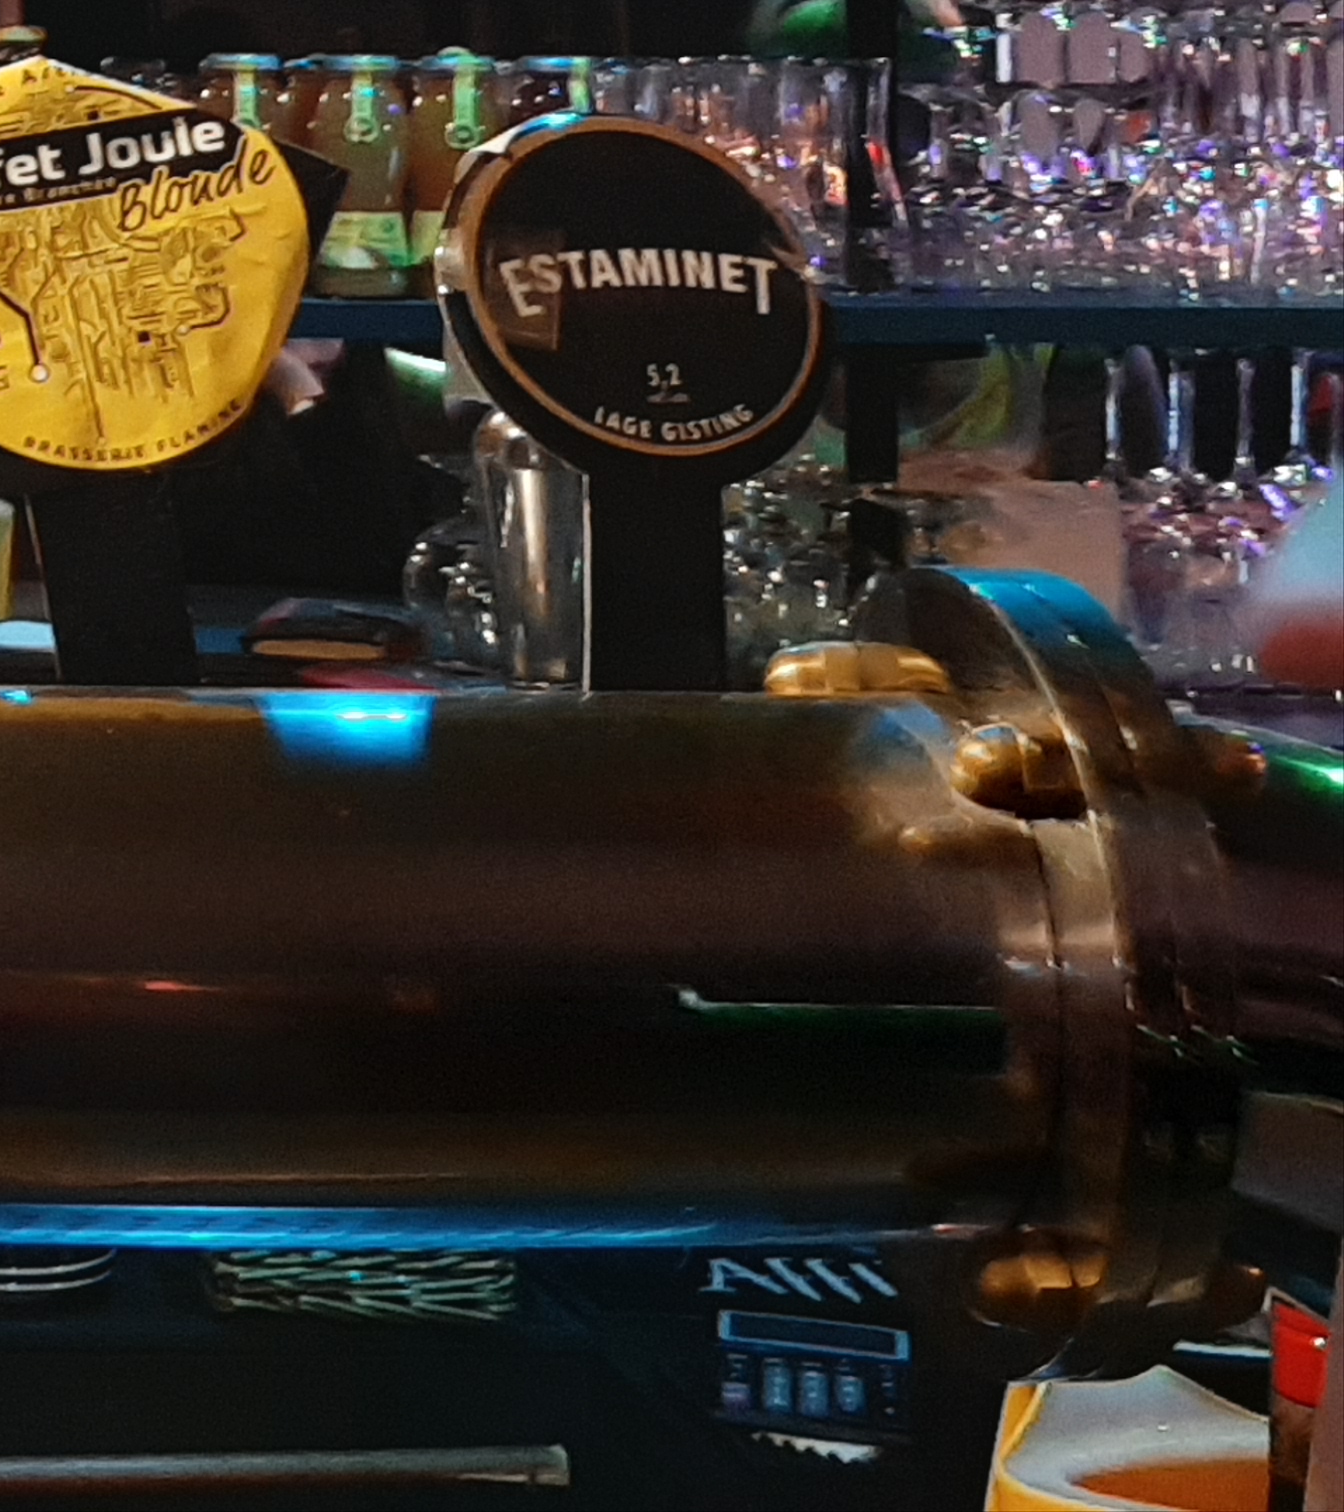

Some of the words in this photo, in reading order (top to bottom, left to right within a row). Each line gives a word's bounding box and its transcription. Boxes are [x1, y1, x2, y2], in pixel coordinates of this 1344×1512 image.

[78, 114, 226, 176] Joule
[116, 136, 280, 234] Blonde
[499, 247, 778, 318] ESTAMINET
[593, 405, 653, 440] LAGE
[660, 403, 755, 442] GISTING
